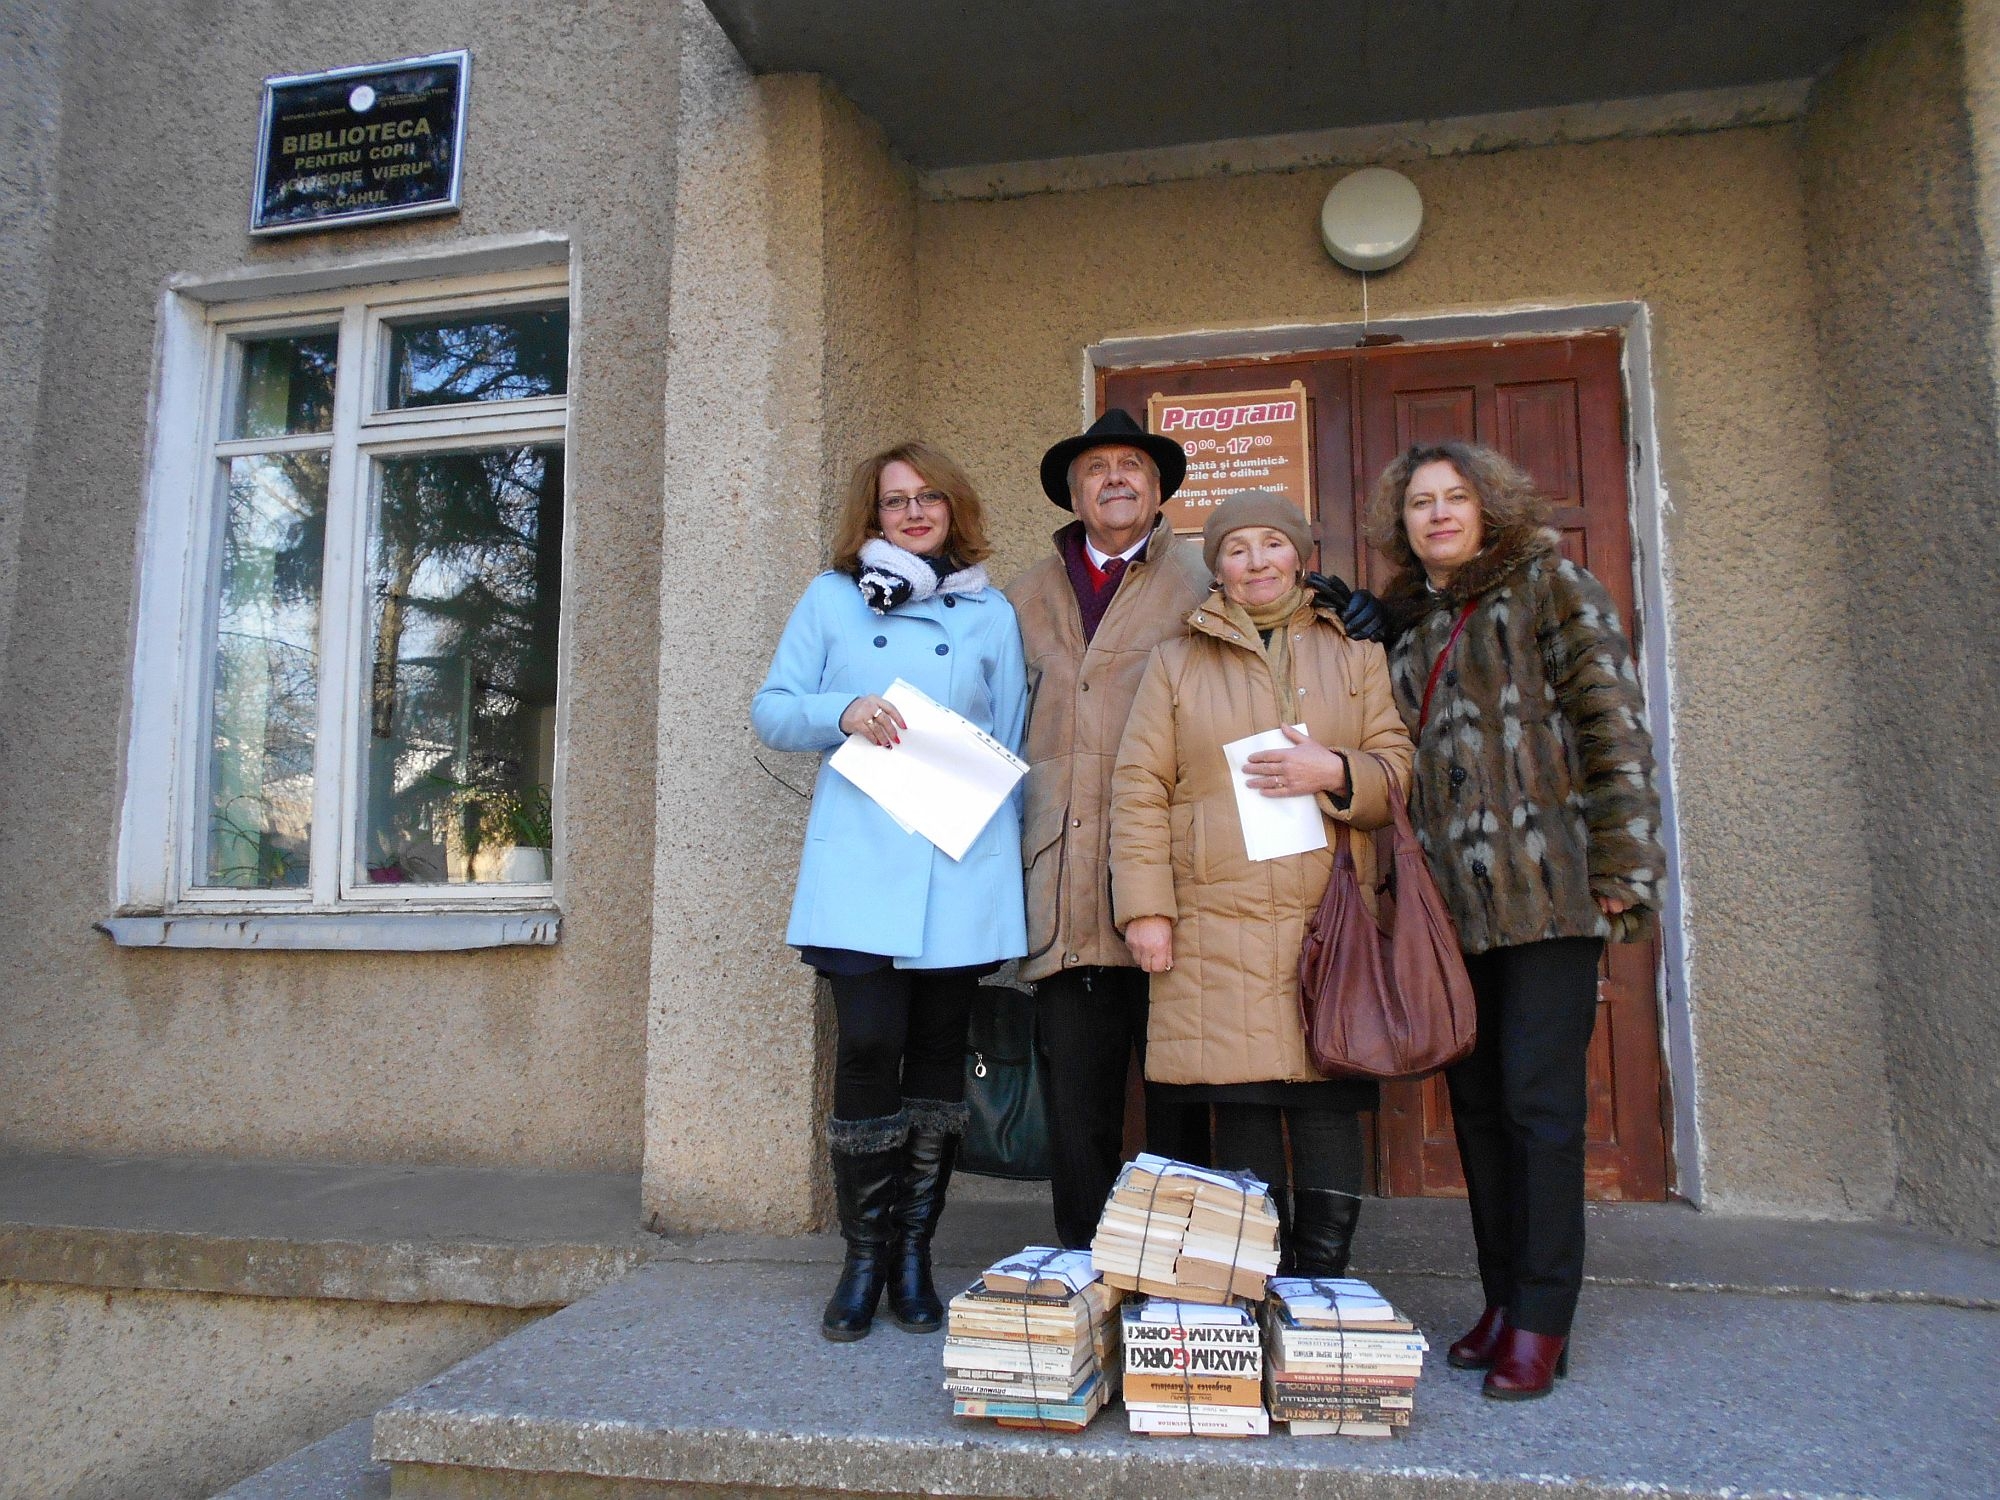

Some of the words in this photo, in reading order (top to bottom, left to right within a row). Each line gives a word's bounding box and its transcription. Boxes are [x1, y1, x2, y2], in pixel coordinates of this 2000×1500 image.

[282, 117, 431, 155] BIBLIOTECA
[295, 150, 361, 170] PENTRU
[369, 142, 415, 160] COPII
[336, 190, 388, 207] CAHUL
[1161, 401, 1295, 431] Program
[1189, 472, 1208, 480] zile
[1212, 470, 1226, 479] de
[1230, 467, 1269, 478] odihnă
[1185, 499, 1194, 507] zi
[1198, 498, 1211, 506] de
[1189, 1328, 1255, 1343] MAXIM
